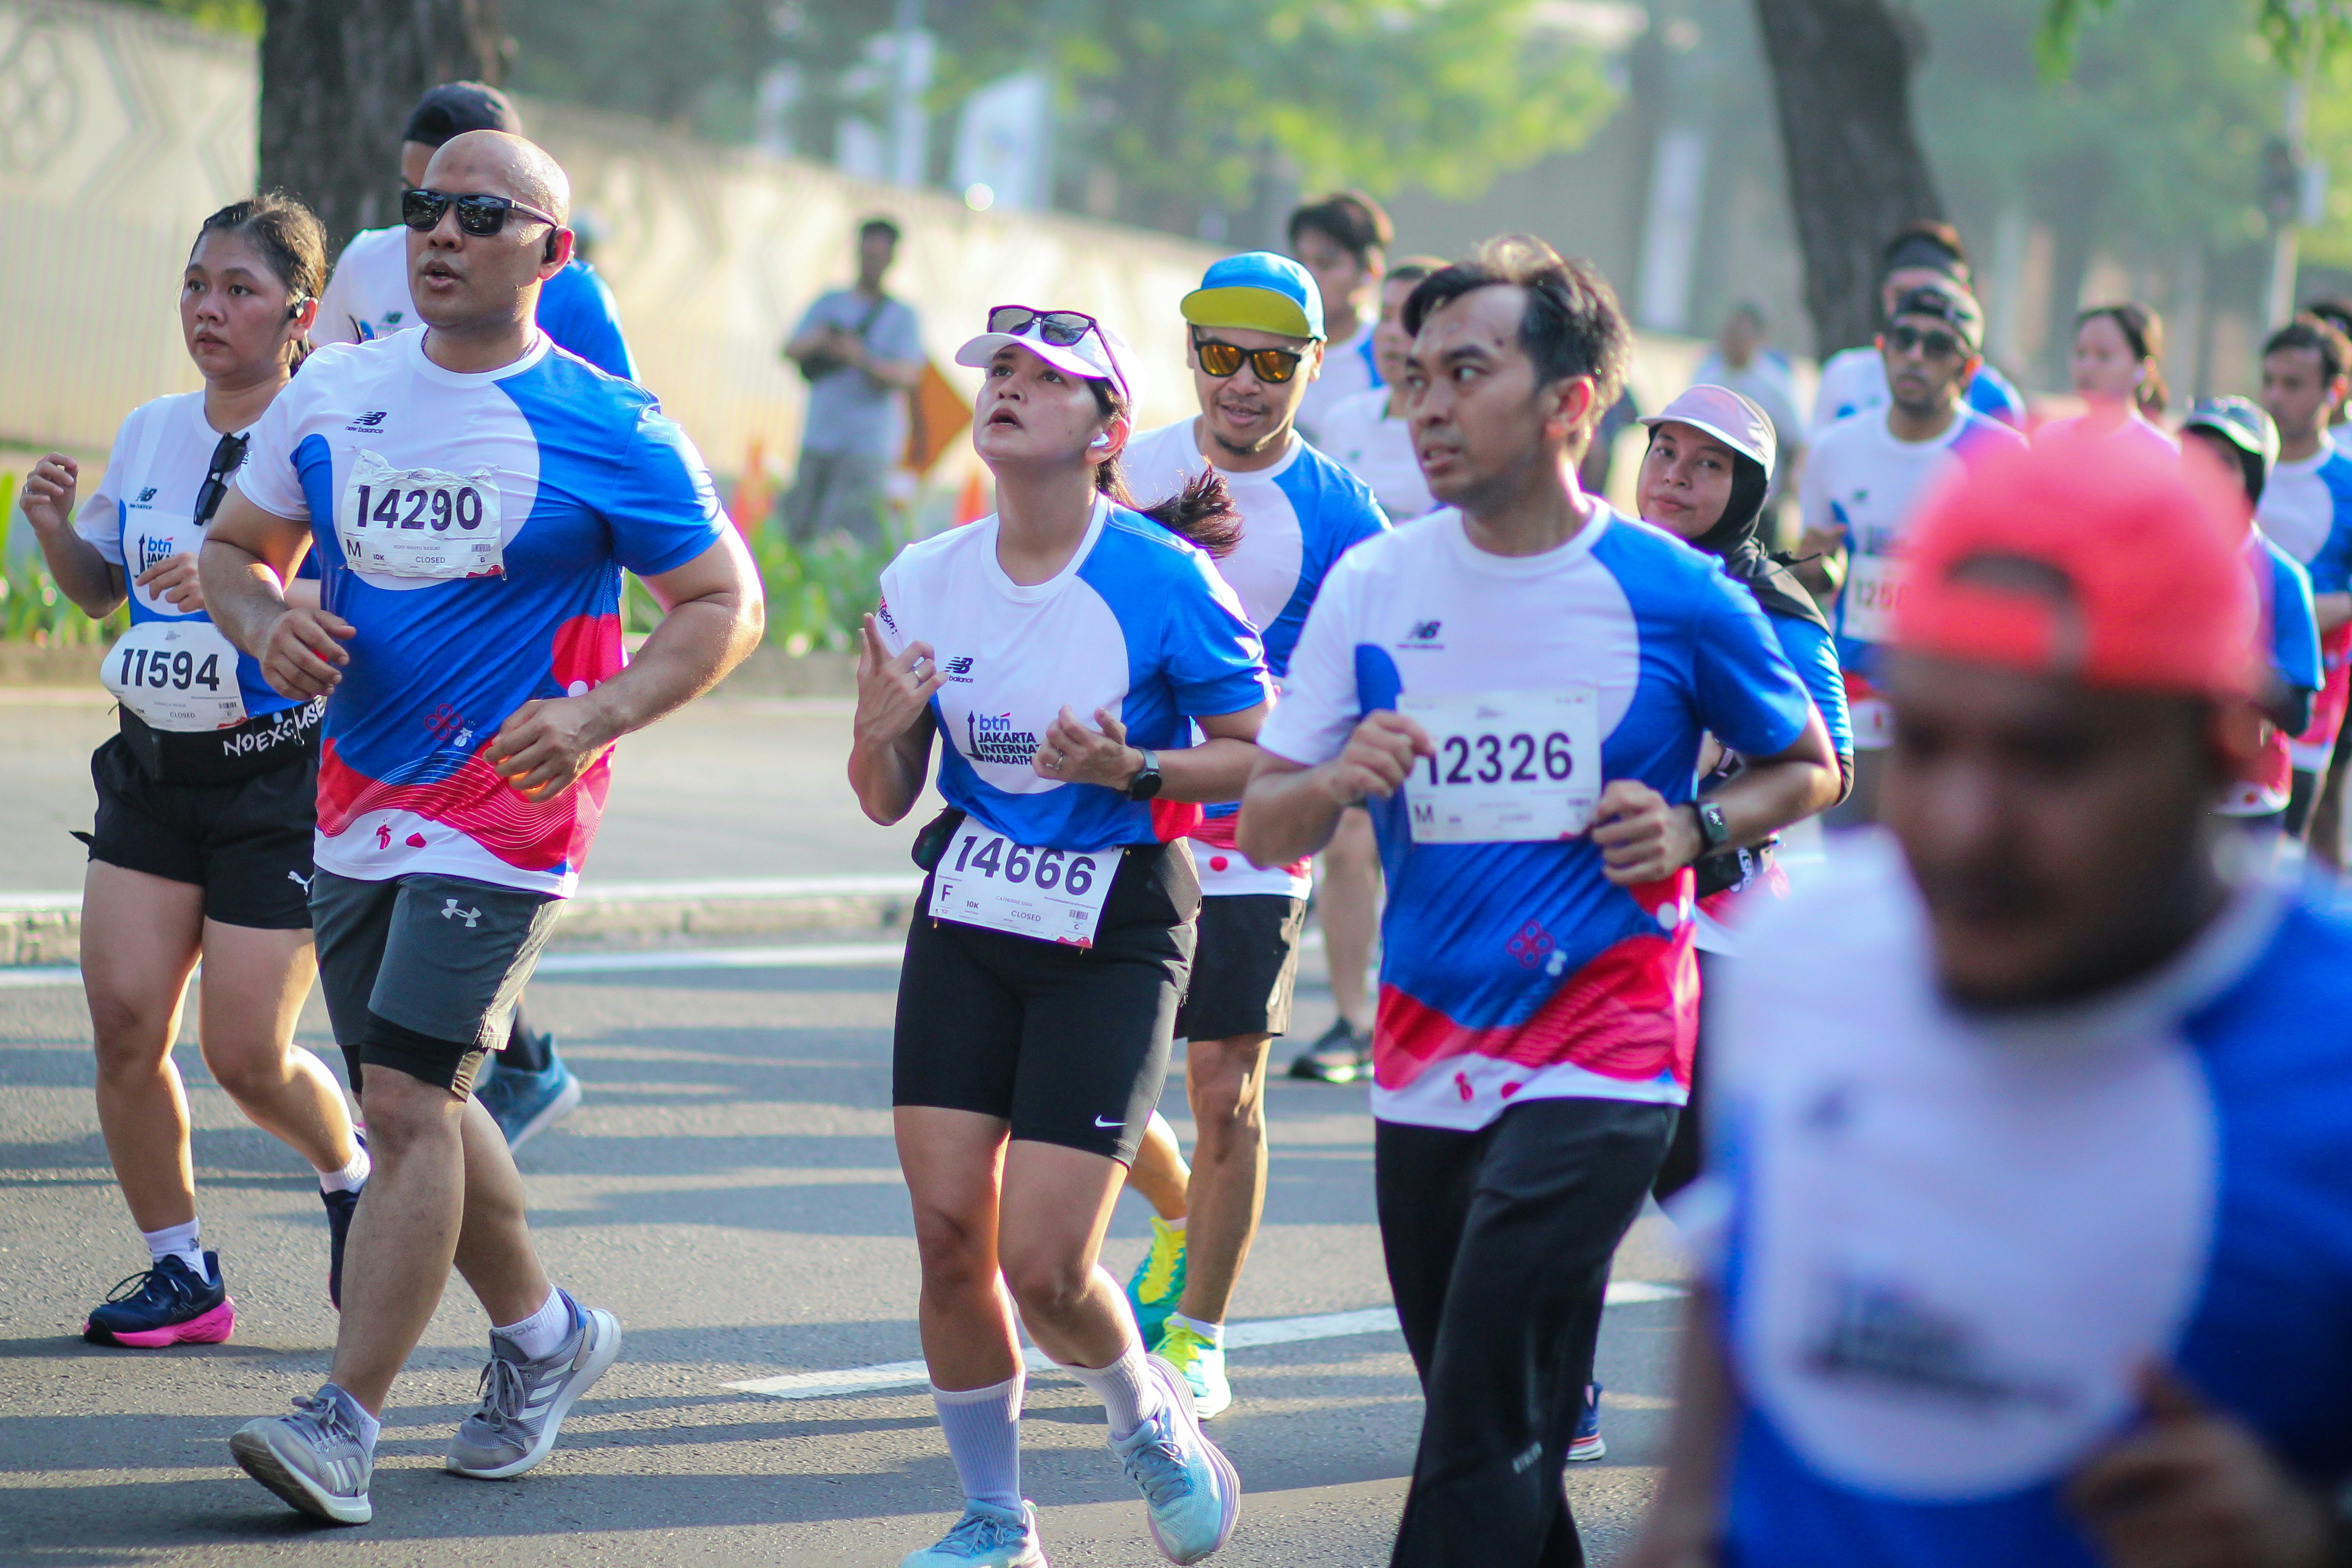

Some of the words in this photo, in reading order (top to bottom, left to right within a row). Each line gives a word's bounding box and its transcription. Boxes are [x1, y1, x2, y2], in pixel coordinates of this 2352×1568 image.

[357, 485, 483, 531] 14290
[346, 539, 362, 558] M
[121, 648, 220, 691] 11594
[949, 675, 973, 683] balance
[979, 712, 1011, 731] btn
[978, 732, 1037, 744] JAKARTA
[1428, 731, 1572, 786] 12326
[1414, 804, 1434, 824] M
[954, 836, 1096, 896] 14666
[941, 884, 953, 901] F
[996, 896, 1020, 904] CATHERINE
[966, 900, 979, 909] 10K
[1011, 910, 1041, 922] CLOSED
